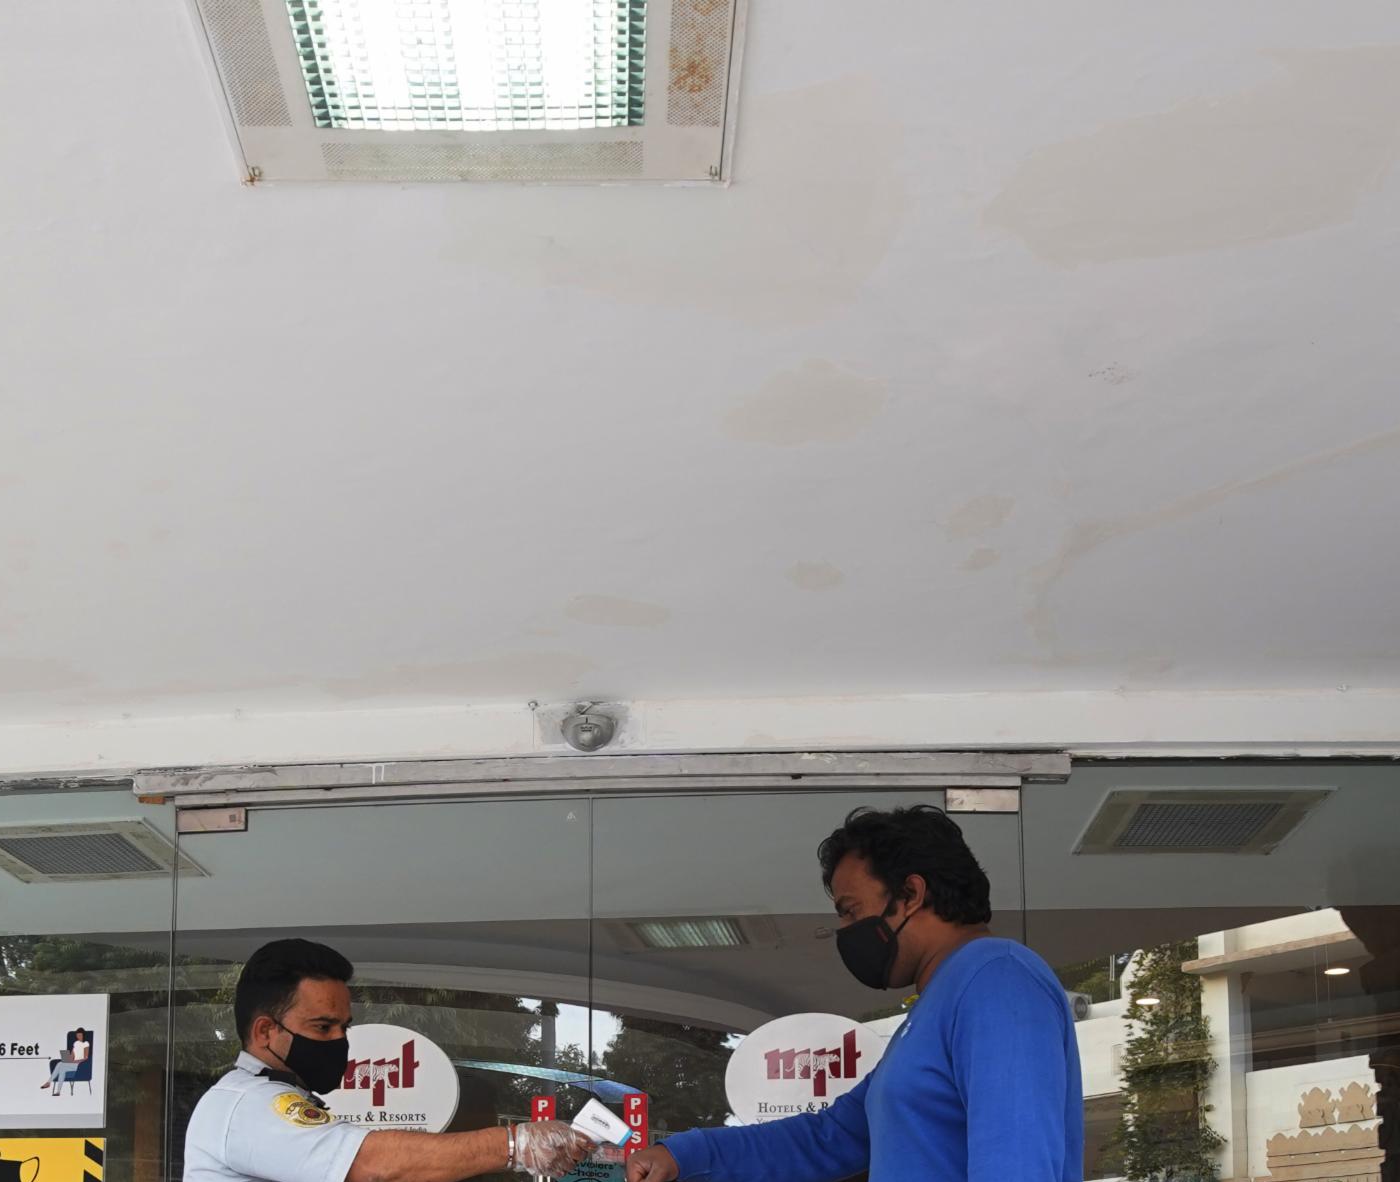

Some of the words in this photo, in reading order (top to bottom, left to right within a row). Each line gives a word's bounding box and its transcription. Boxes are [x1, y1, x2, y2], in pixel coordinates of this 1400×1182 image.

[10, 1042, 39, 1056] Feet
[806, 1101, 816, 1112] &
[365, 1110, 375, 1122] &
[629, 1097, 643, 1153] PUS
